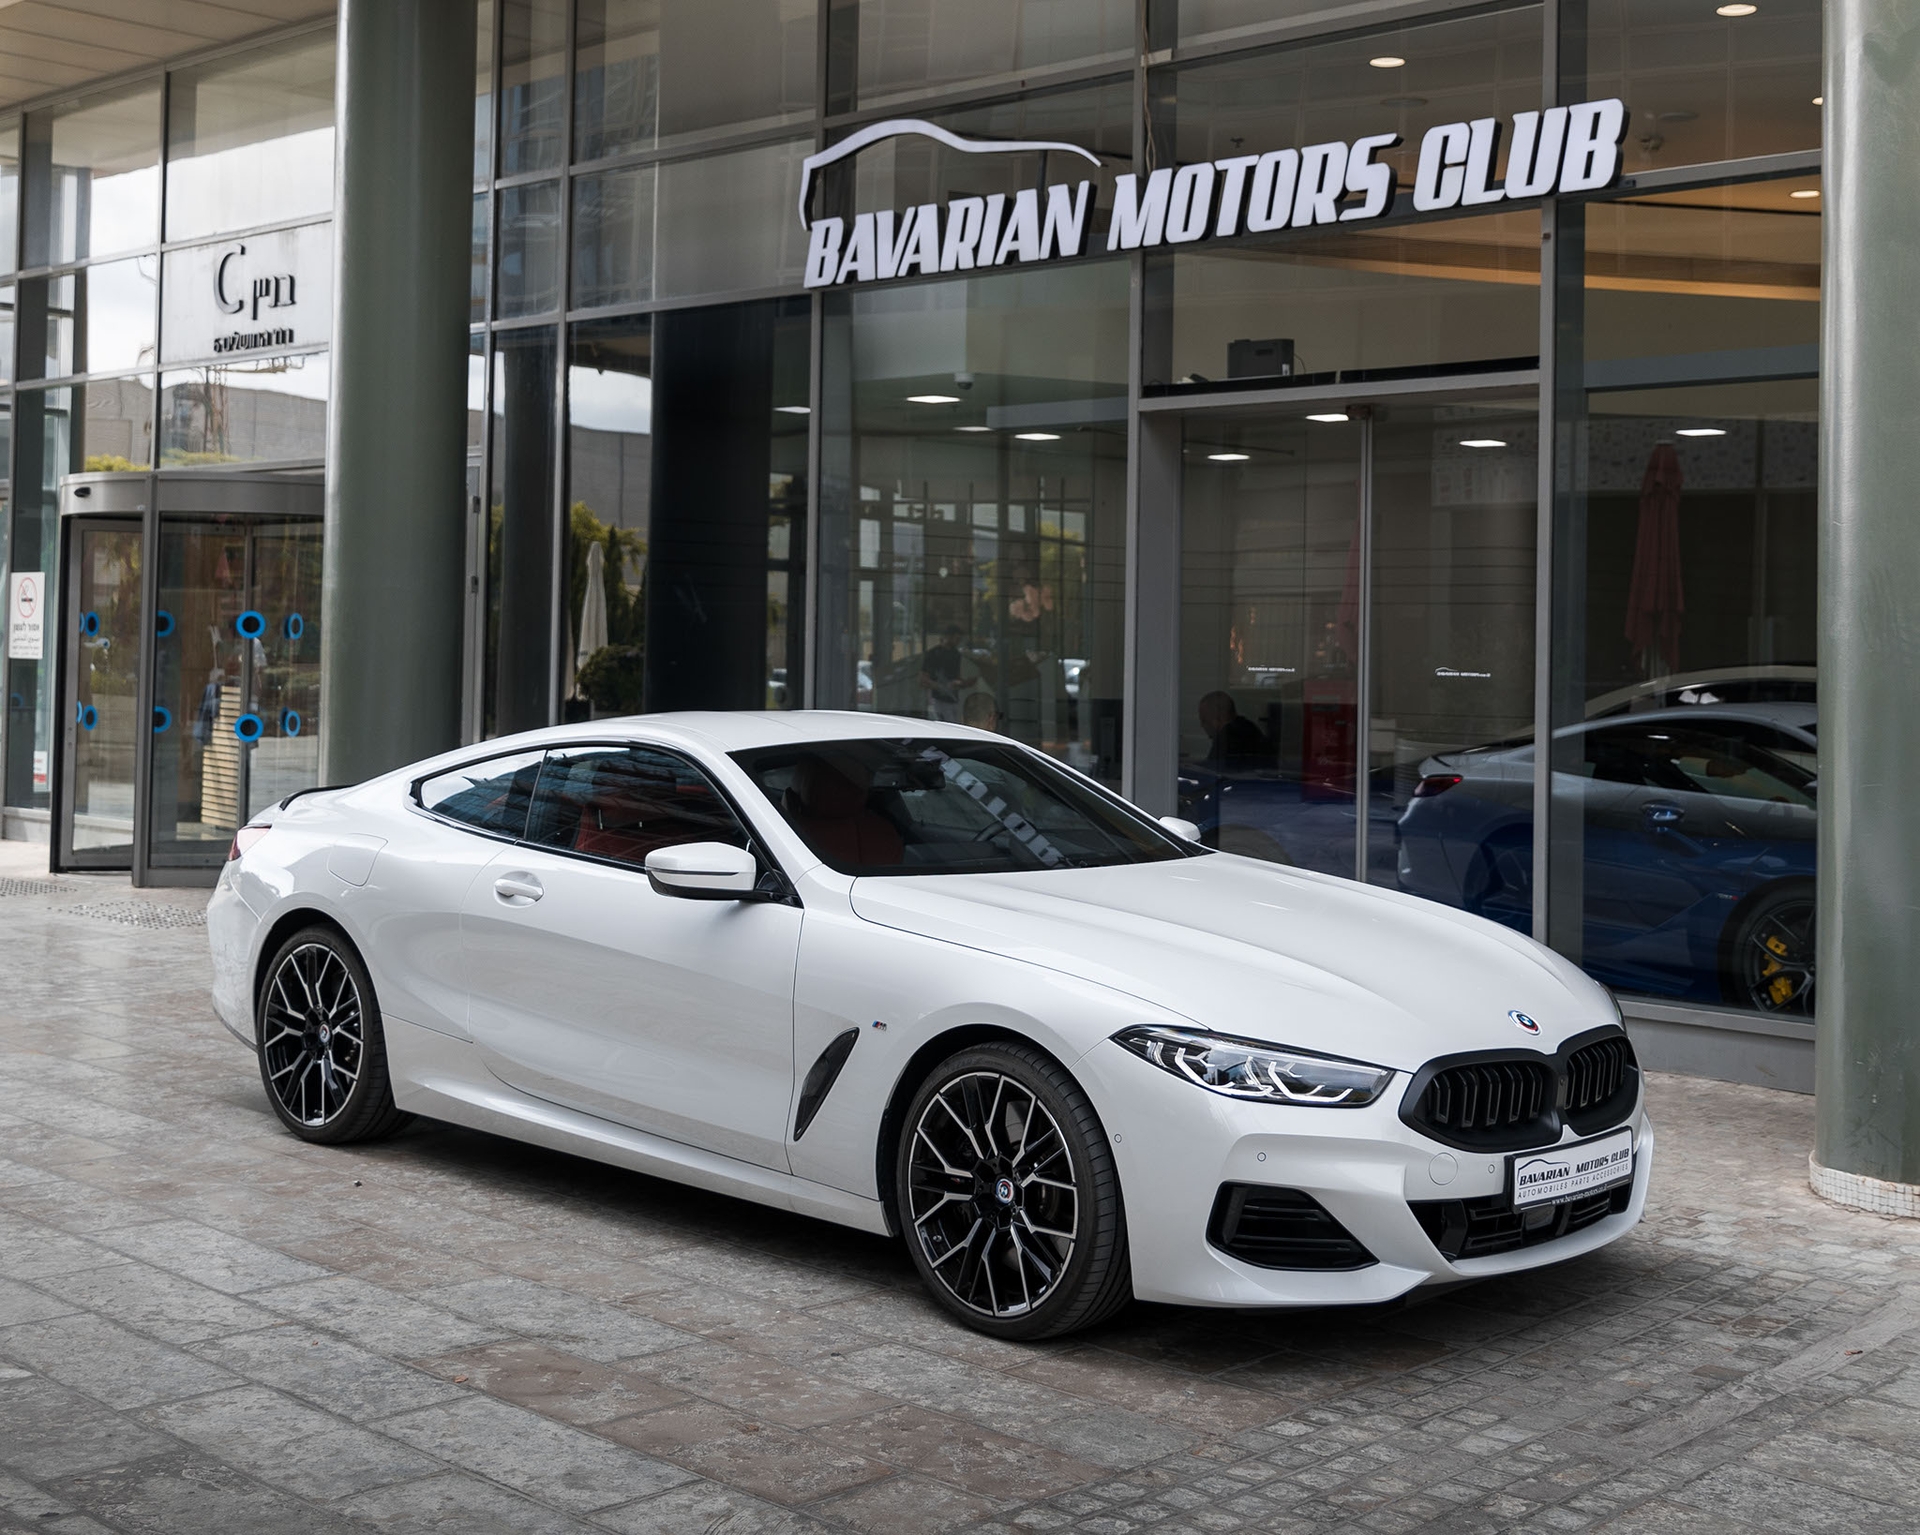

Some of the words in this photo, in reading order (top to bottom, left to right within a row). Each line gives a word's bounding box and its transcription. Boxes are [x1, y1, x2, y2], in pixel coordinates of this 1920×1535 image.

[803, 180, 1092, 289] BAVARIAN
[1107, 133, 1400, 251] MOTORS
[1413, 98, 1627, 213] CLUB
[1517, 1181, 1568, 1199] AUTOMOBILES
[1571, 1176, 1590, 1187] PARTS
[1592, 1163, 1629, 1181] ACCESSORIES
[1519, 1166, 1570, 1186] BAVARIAN
[1575, 1154, 1610, 1174] MOTORS
[1611, 1148, 1630, 1163] CLUB
